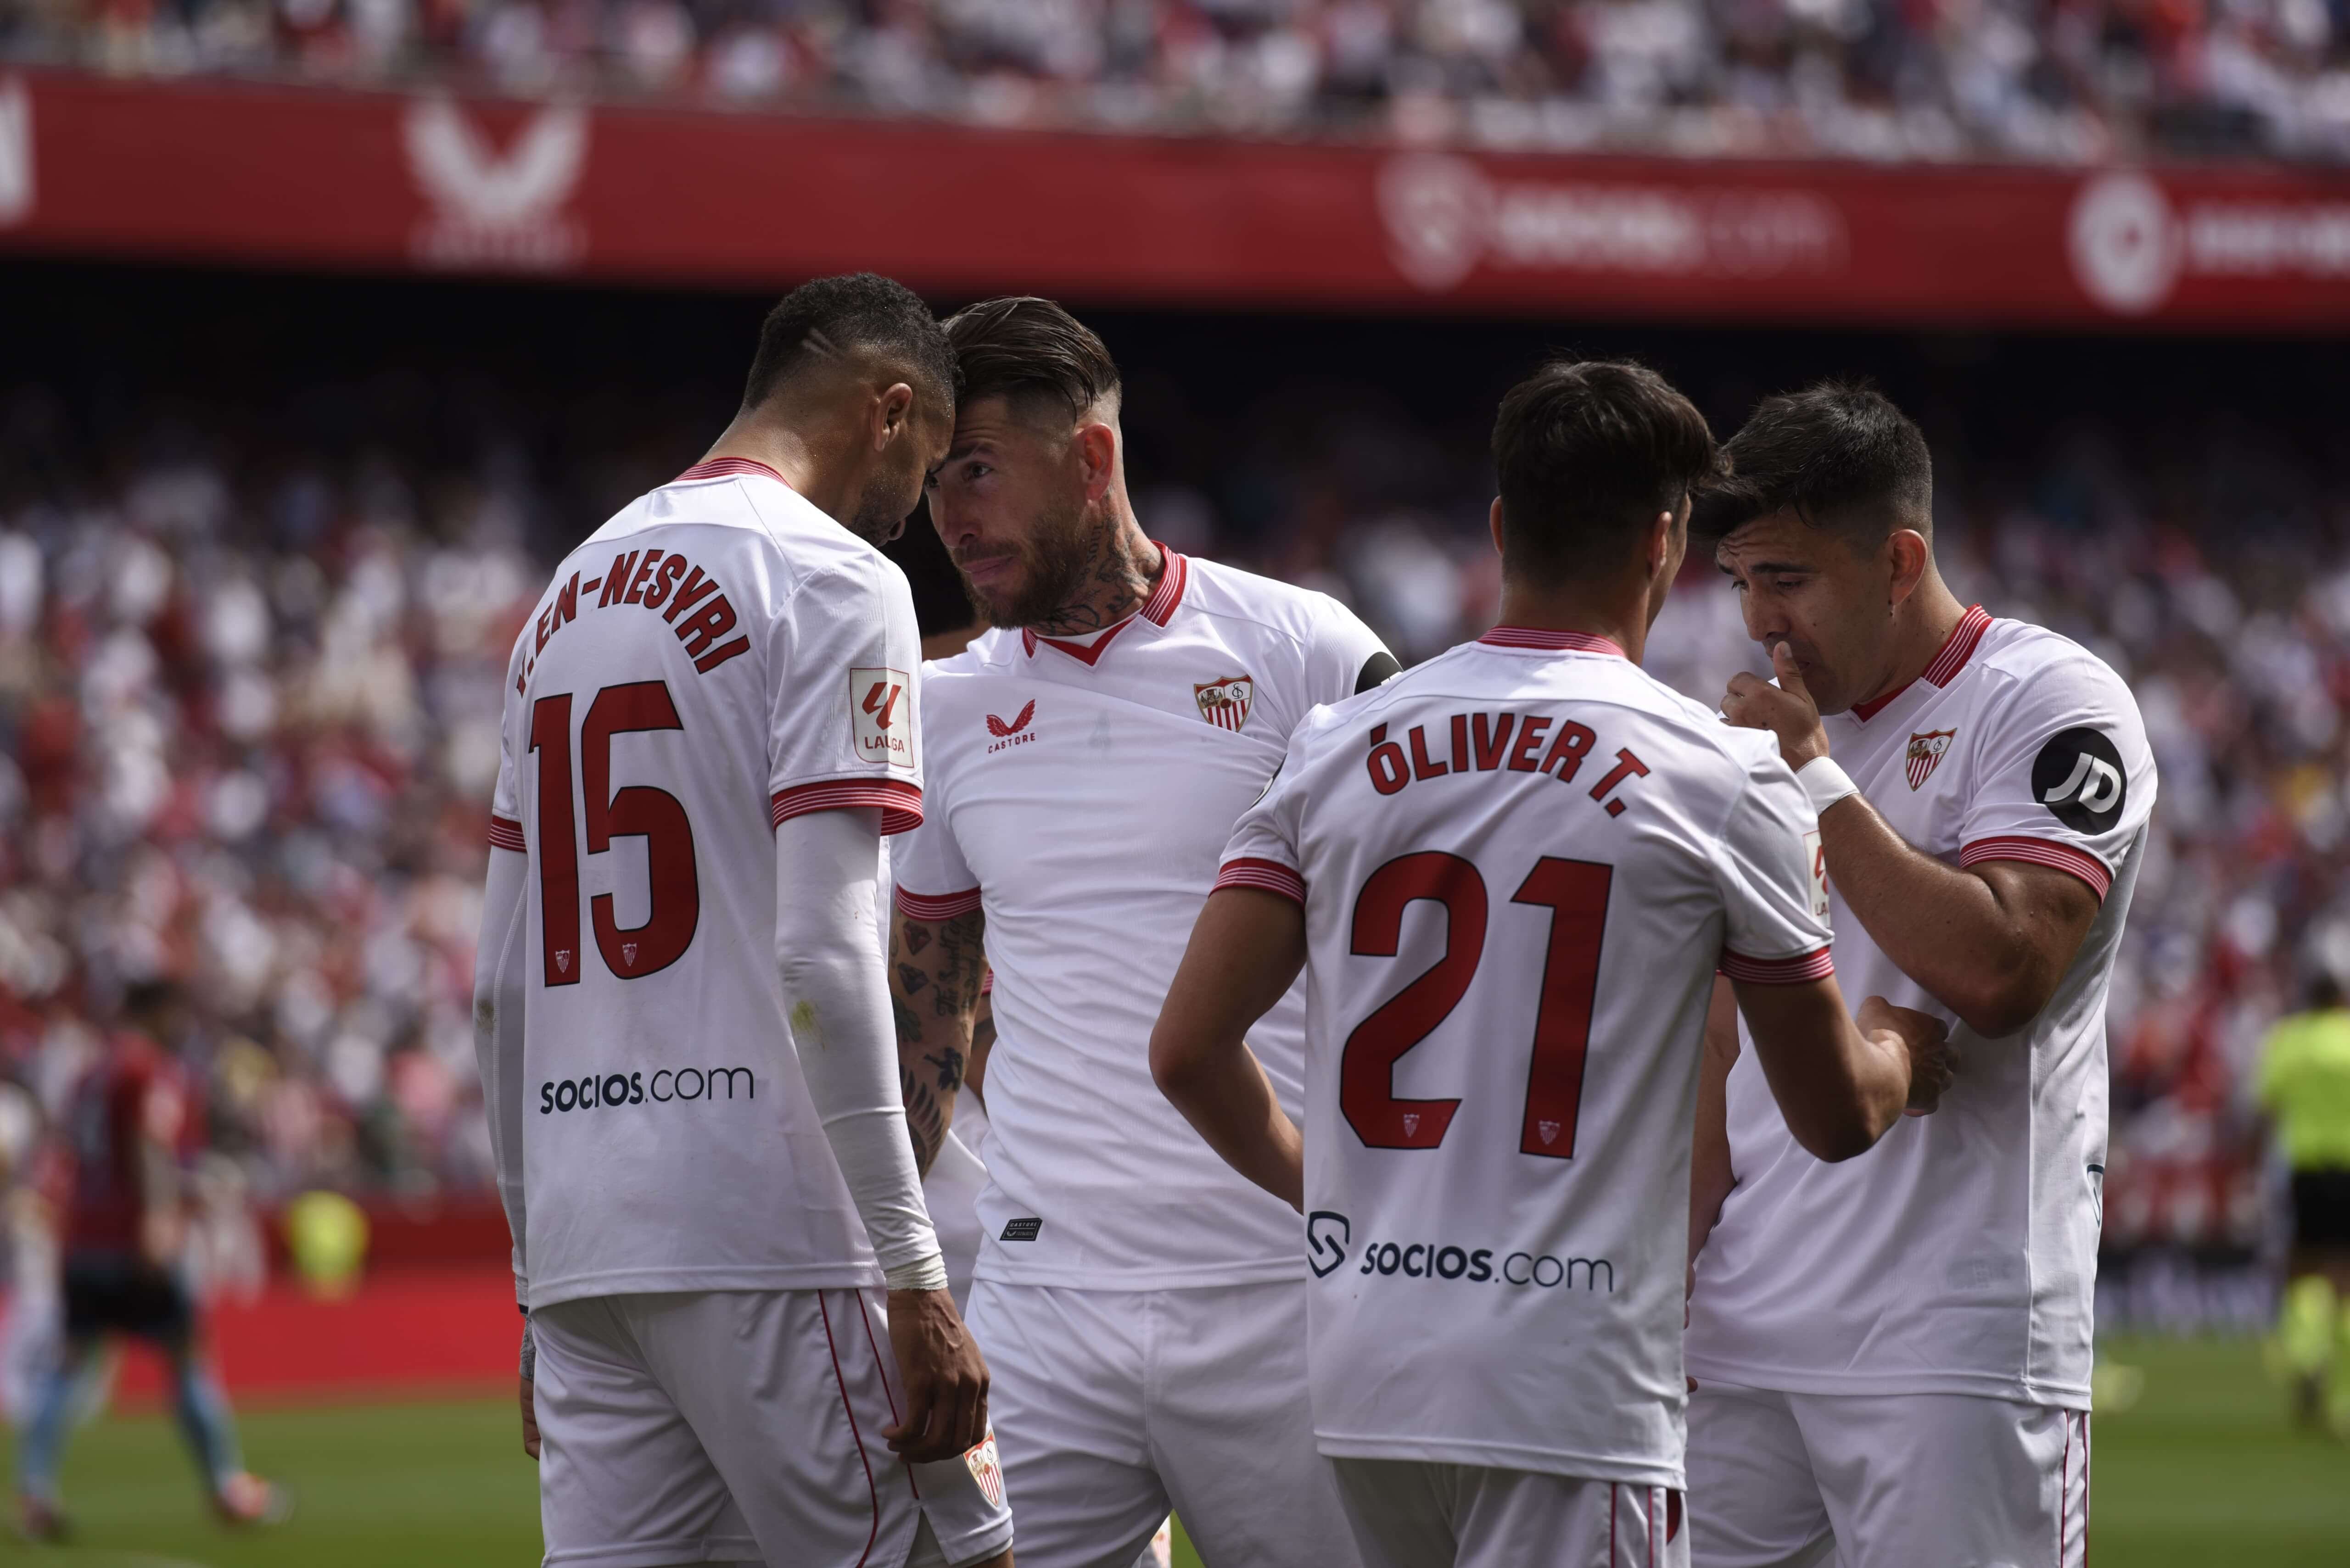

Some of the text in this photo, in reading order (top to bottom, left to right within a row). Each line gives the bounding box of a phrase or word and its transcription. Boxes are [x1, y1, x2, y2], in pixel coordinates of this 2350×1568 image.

[536, 549, 751, 675] EN-NESYRI
[865, 735, 905, 753] LALIGA
[988, 732, 1036, 754] CASTORE
[1366, 712, 1651, 818] ÓLIVER T.
[2043, 752, 2122, 814] JD
[528, 680, 700, 987] 15
[1340, 850, 1614, 1159] 21
